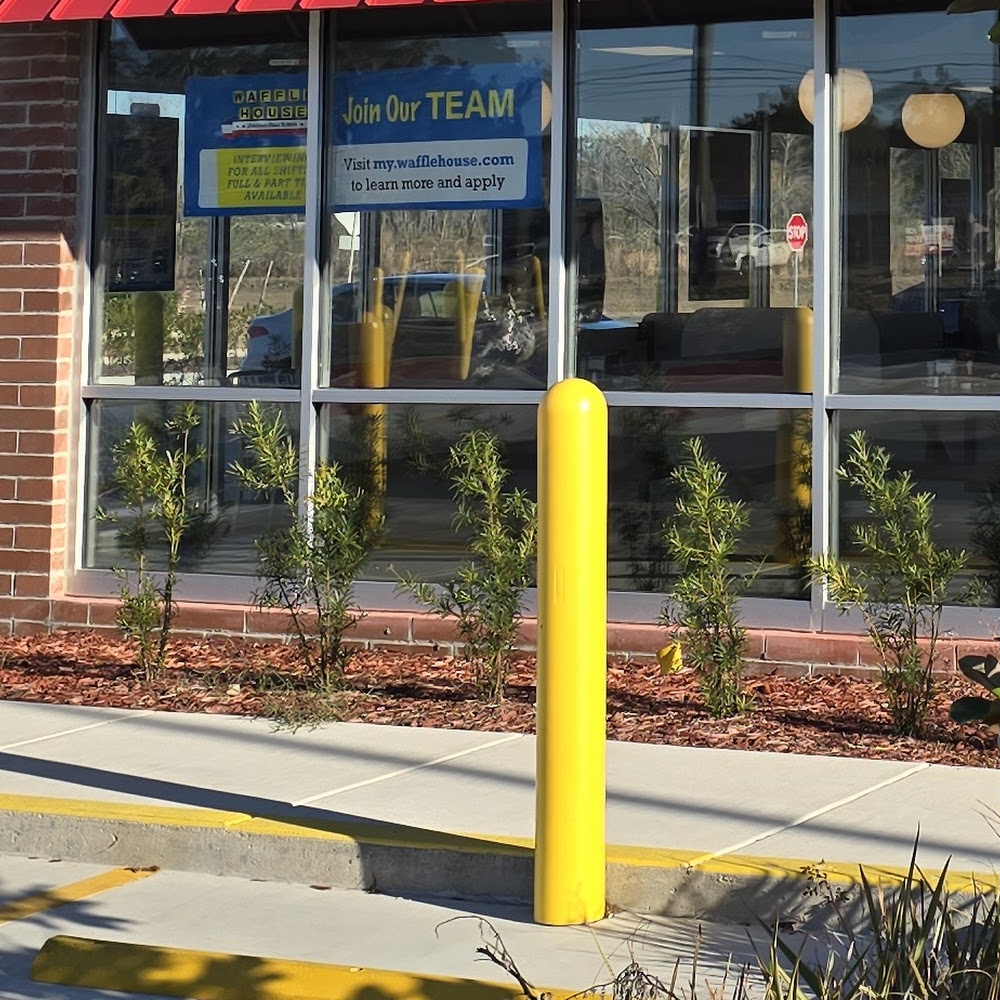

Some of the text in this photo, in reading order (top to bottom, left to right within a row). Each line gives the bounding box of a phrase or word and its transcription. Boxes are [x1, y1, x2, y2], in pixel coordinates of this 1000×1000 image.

[240, 106, 306, 119] HOUSE
[342, 88, 515, 125] Join Our TEAM
[233, 152, 308, 165] INTERVIEWIN
[343, 154, 515, 174] Visit my.wafflehouse.com
[227, 166, 248, 177] FOR
[250, 166, 270, 176] ALL
[226, 179, 251, 189] FULL
[253, 179, 261, 188] &
[264, 178, 290, 188] PART
[351, 174, 506, 191] to learn more and apply
[243, 190, 302, 201] AVAILABLE
[788, 225, 807, 240] STOP
